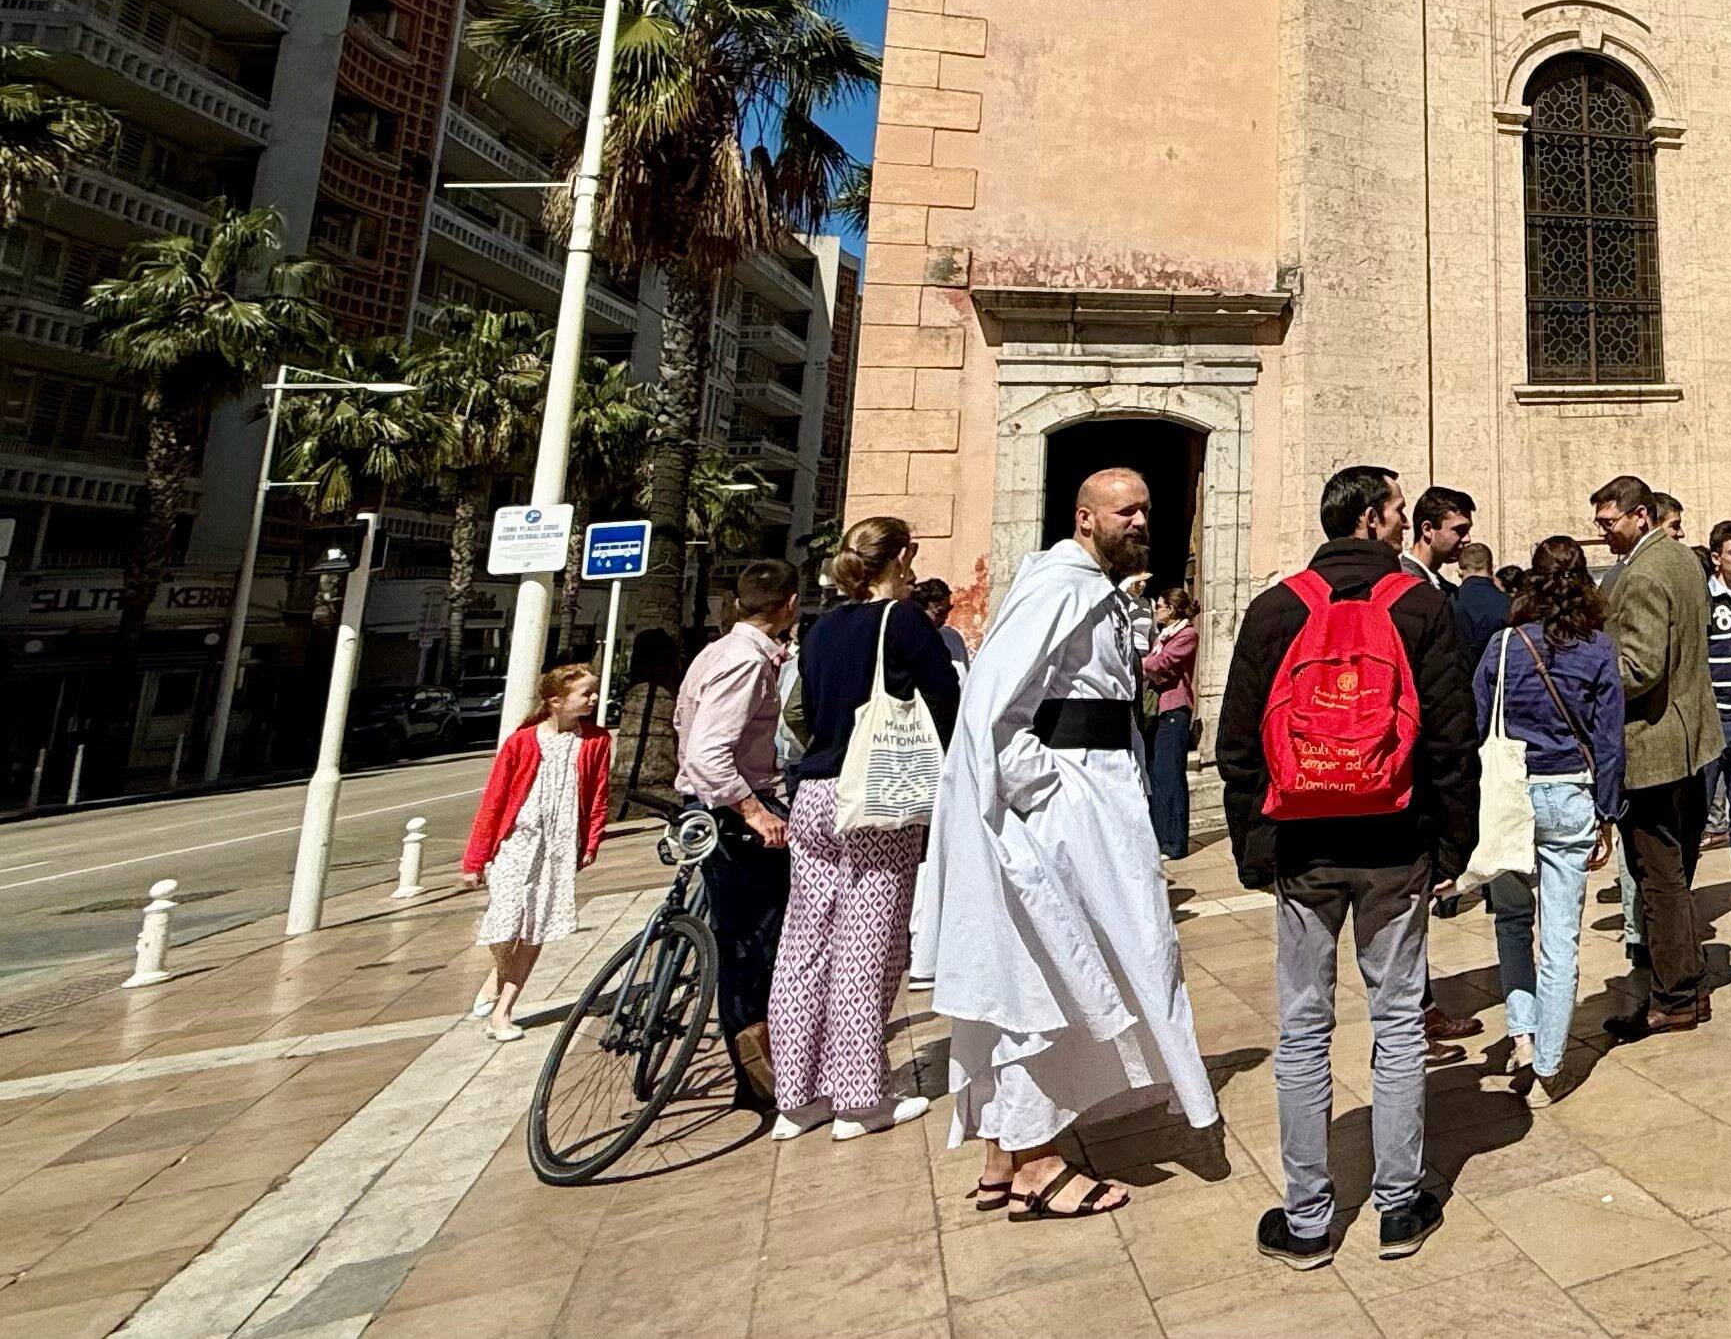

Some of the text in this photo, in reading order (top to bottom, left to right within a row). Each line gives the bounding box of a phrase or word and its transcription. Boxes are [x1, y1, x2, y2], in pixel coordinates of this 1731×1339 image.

[30, 587, 126, 613] SULTA
[885, 719, 922, 734] MARINE
[872, 733, 934, 747] NATIONALE
[1345, 756, 1363, 771] ad
[1294, 772, 1356, 791] Dominum
